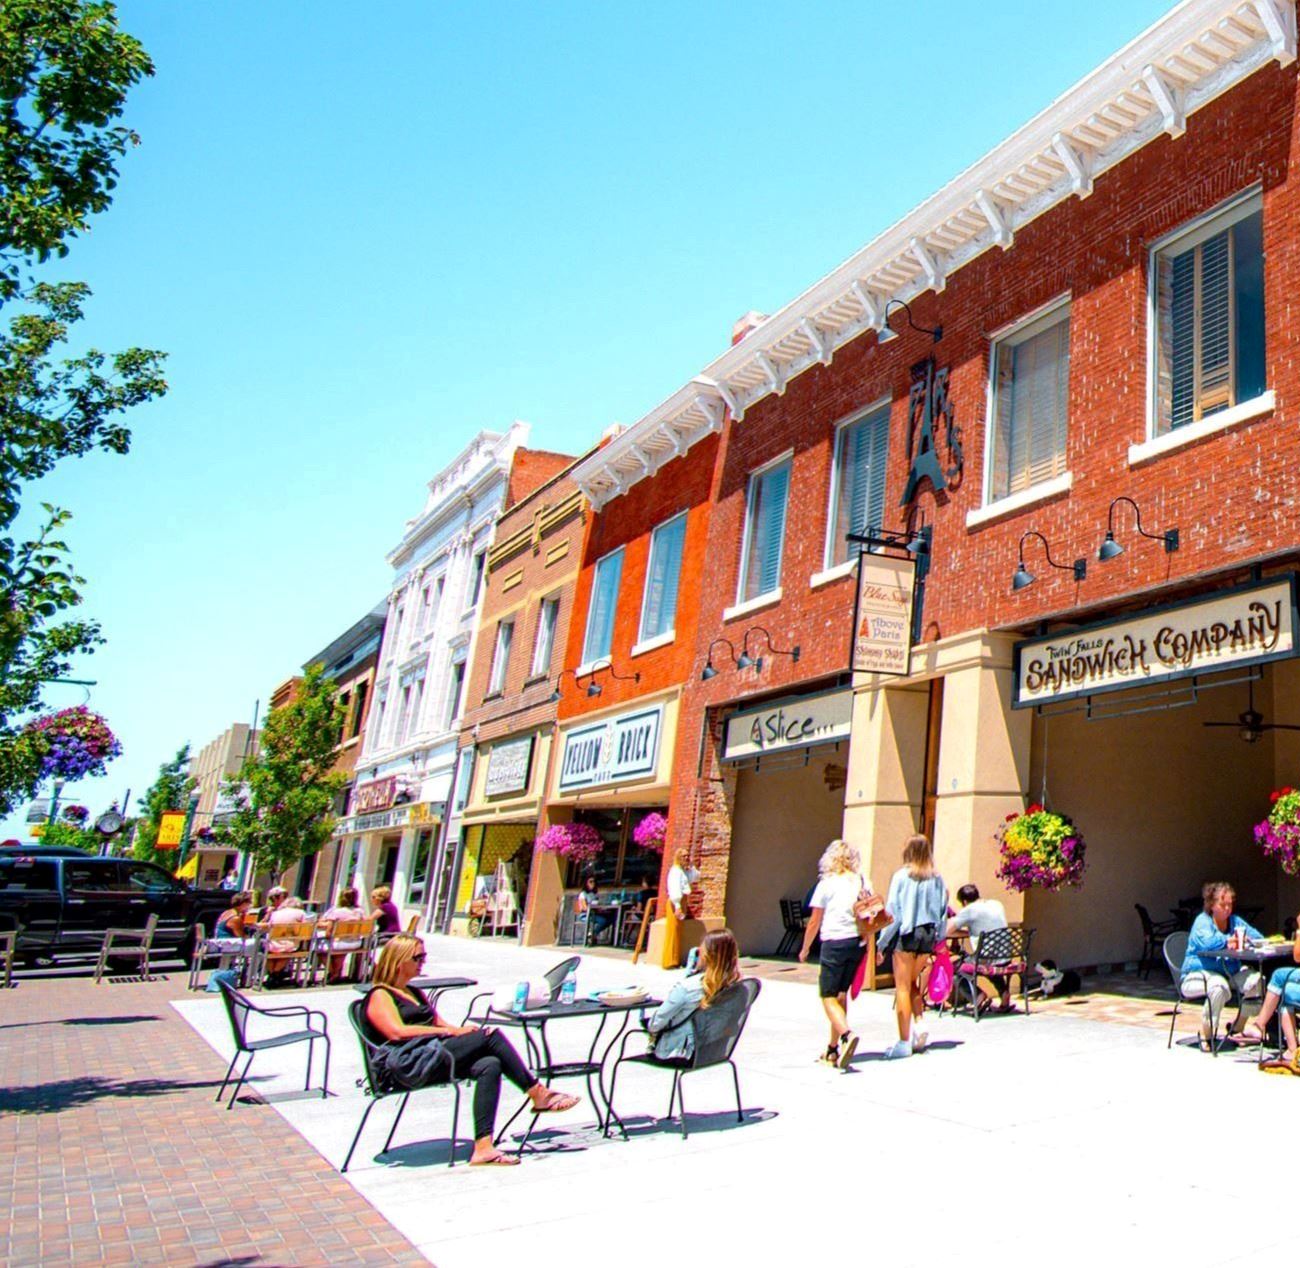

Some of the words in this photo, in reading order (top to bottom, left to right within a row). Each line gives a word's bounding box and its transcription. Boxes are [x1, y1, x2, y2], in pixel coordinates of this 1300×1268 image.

[872, 627, 901, 640] Paris
[1026, 634, 1151, 693] SANDWICH
[1153, 600, 1282, 667] COMPANY
[1046, 645, 1073, 660] TWIN
[1074, 638, 1104, 656] FALLS
[565, 736, 603, 776] YELLOW
[617, 723, 652, 765] BRICK
